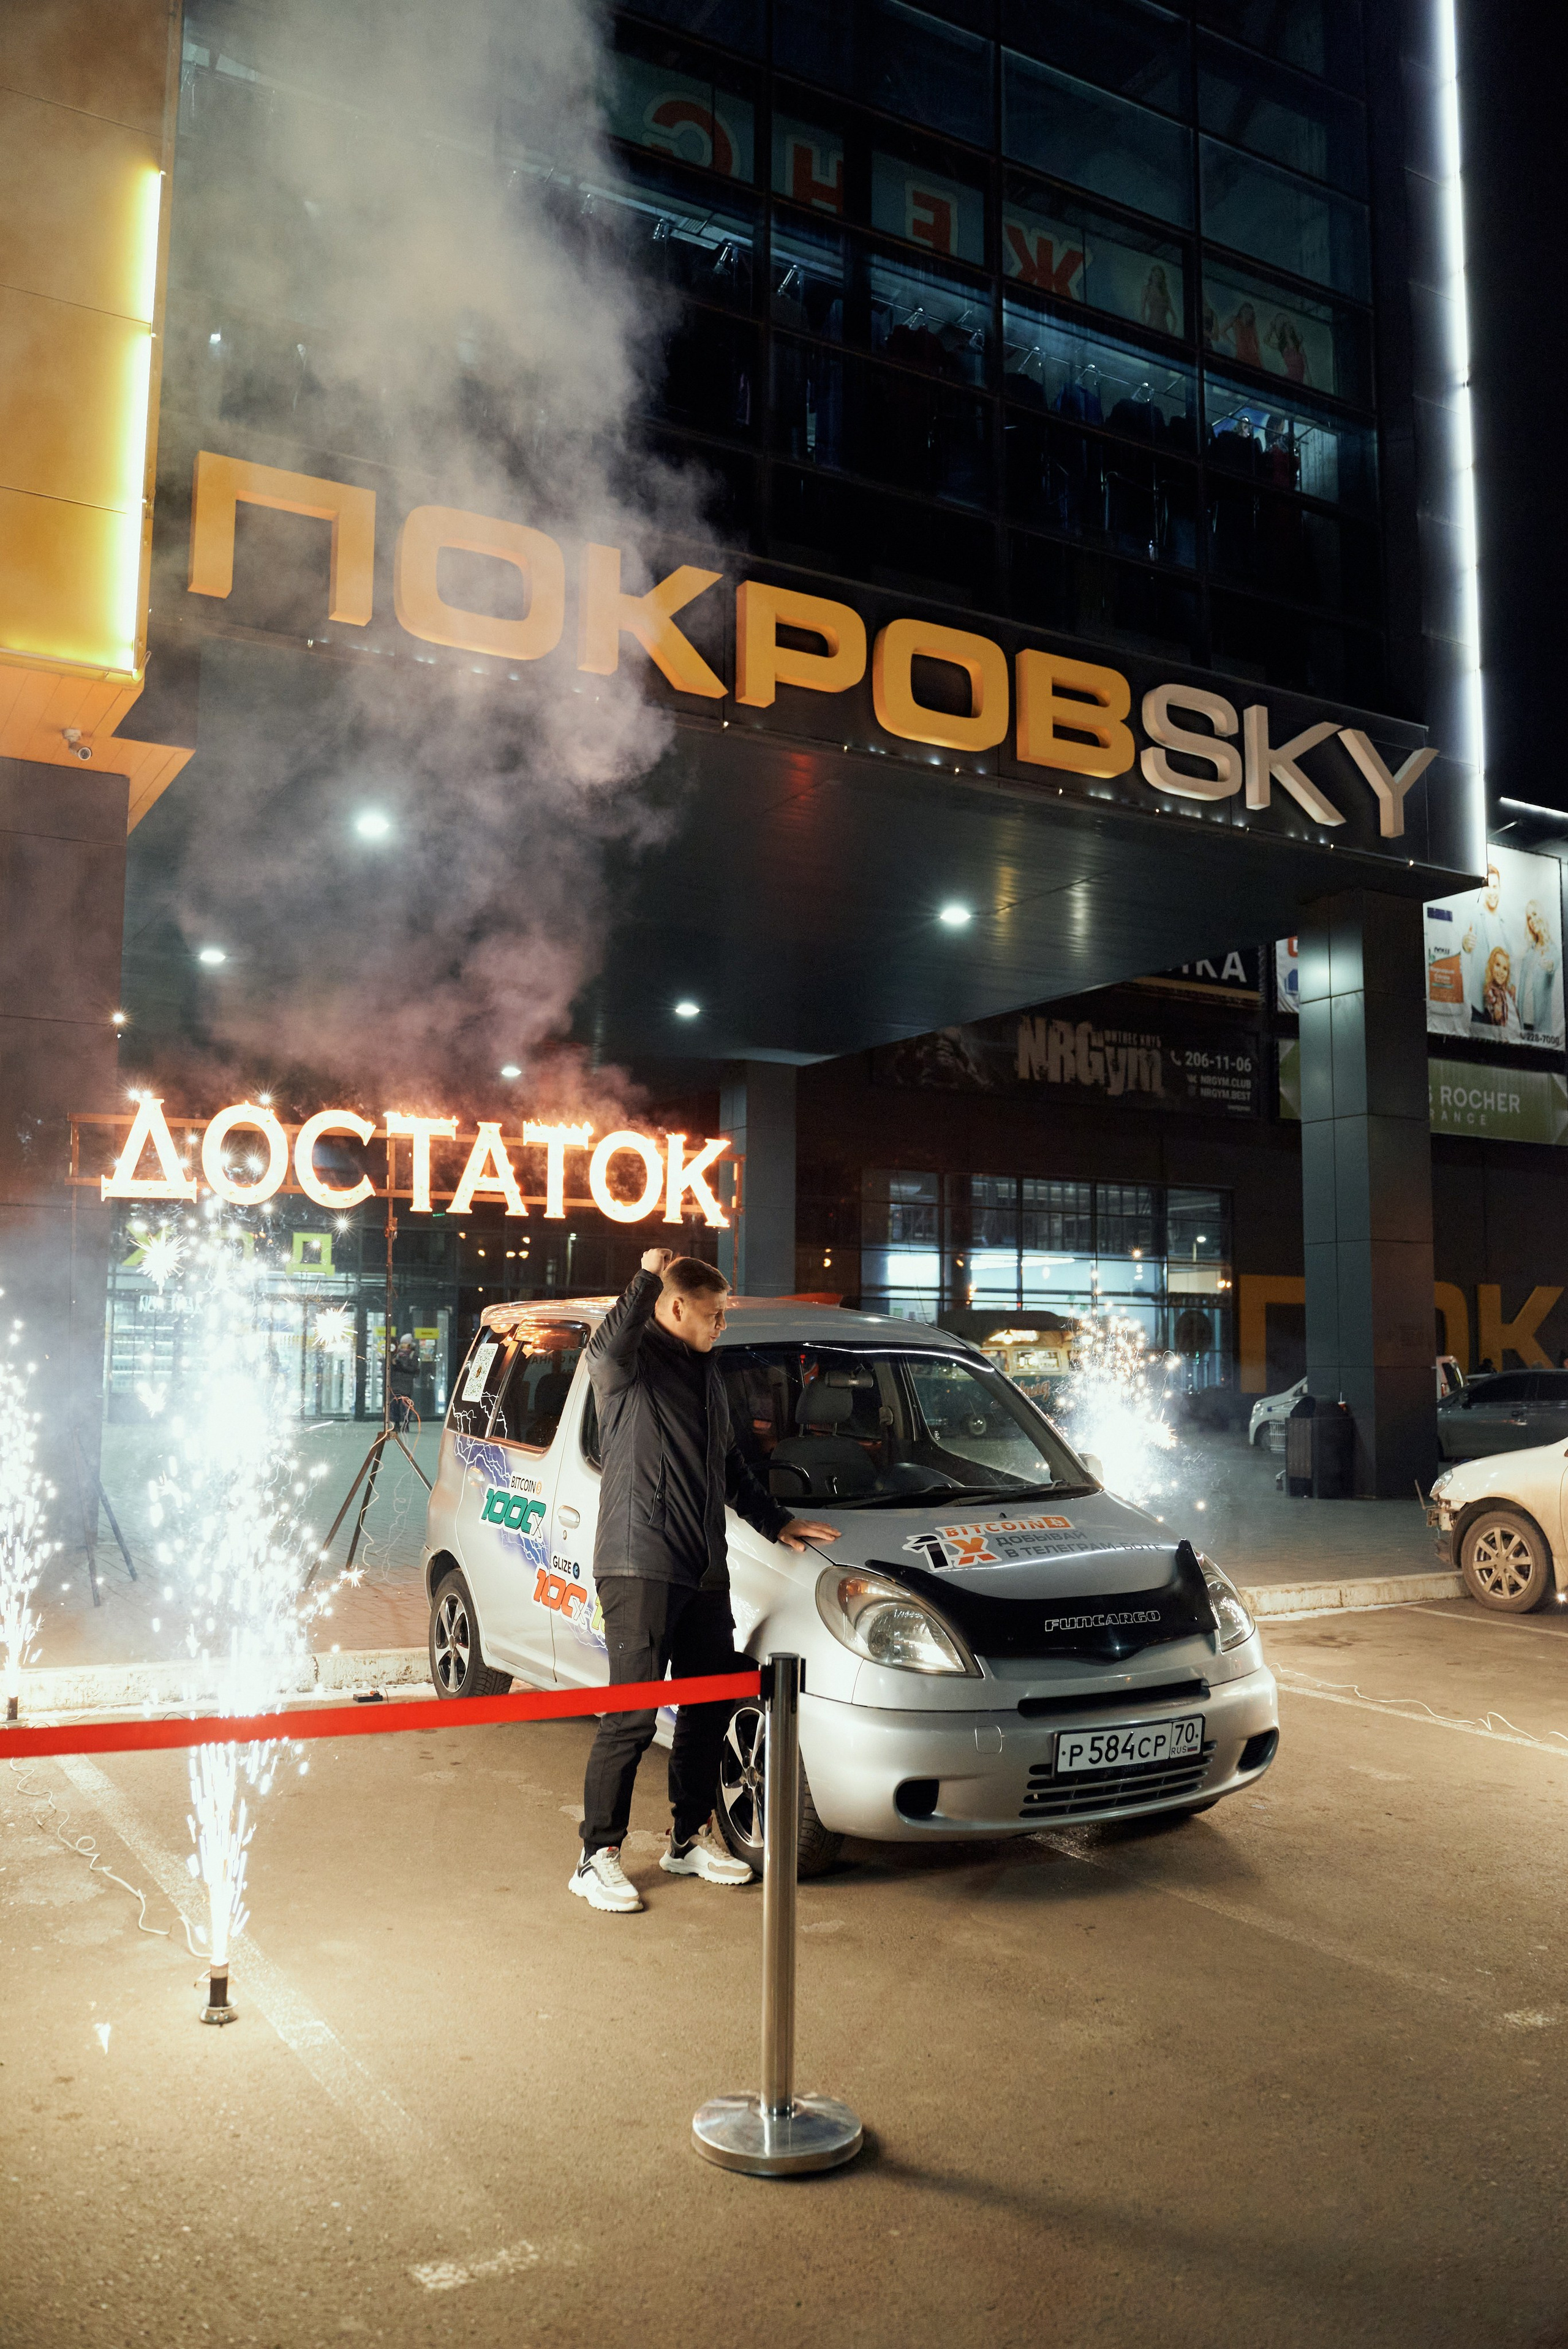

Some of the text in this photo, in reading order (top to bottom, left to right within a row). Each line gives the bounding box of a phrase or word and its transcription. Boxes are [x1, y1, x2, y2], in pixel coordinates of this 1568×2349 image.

[1185, 1050, 1252, 1073] 206-11-06
[1440, 1085, 1520, 1114] ROCHER
[100, 1093, 731, 1229] ДОСТАТОК
[510, 1476, 537, 1494] BITCOIN
[942, 1520, 1044, 1538] BITCOIN
[995, 1530, 1088, 1547] ДОБЫВАЙ
[1005, 1542, 1164, 1558] В ТЕЛЕГРАМ-БОТЕ
[553, 1555, 572, 1575] GLIZE
[1175, 1722, 1195, 1746] 70
[1170, 1745, 1187, 1755] RUS
